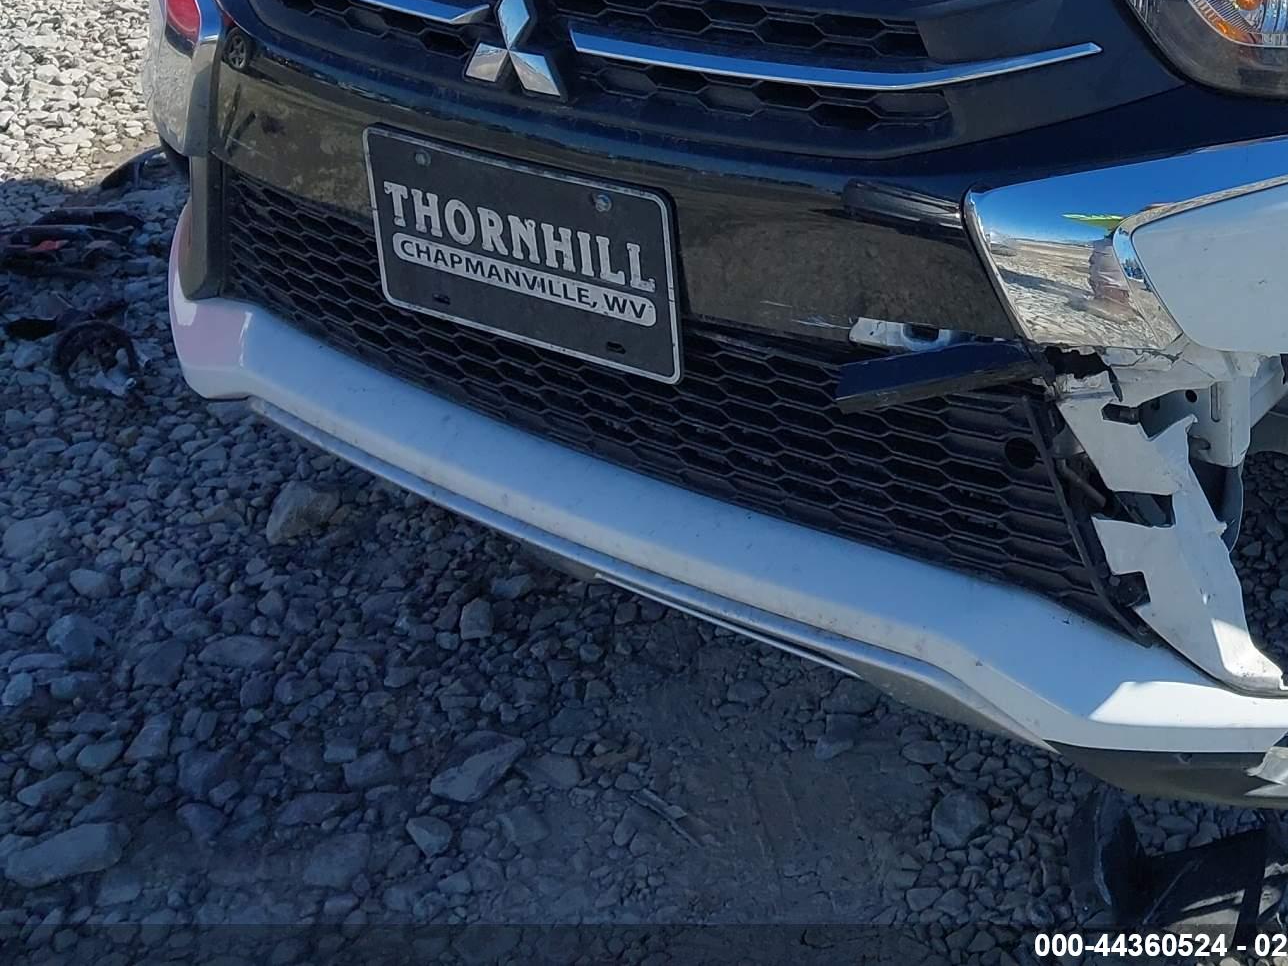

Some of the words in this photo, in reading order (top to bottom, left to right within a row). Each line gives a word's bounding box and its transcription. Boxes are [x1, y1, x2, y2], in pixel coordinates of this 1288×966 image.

[383, 181, 656, 293] THORNHILL
[400, 239, 598, 309] CHAPMANVILLE,
[603, 292, 647, 319] WV
